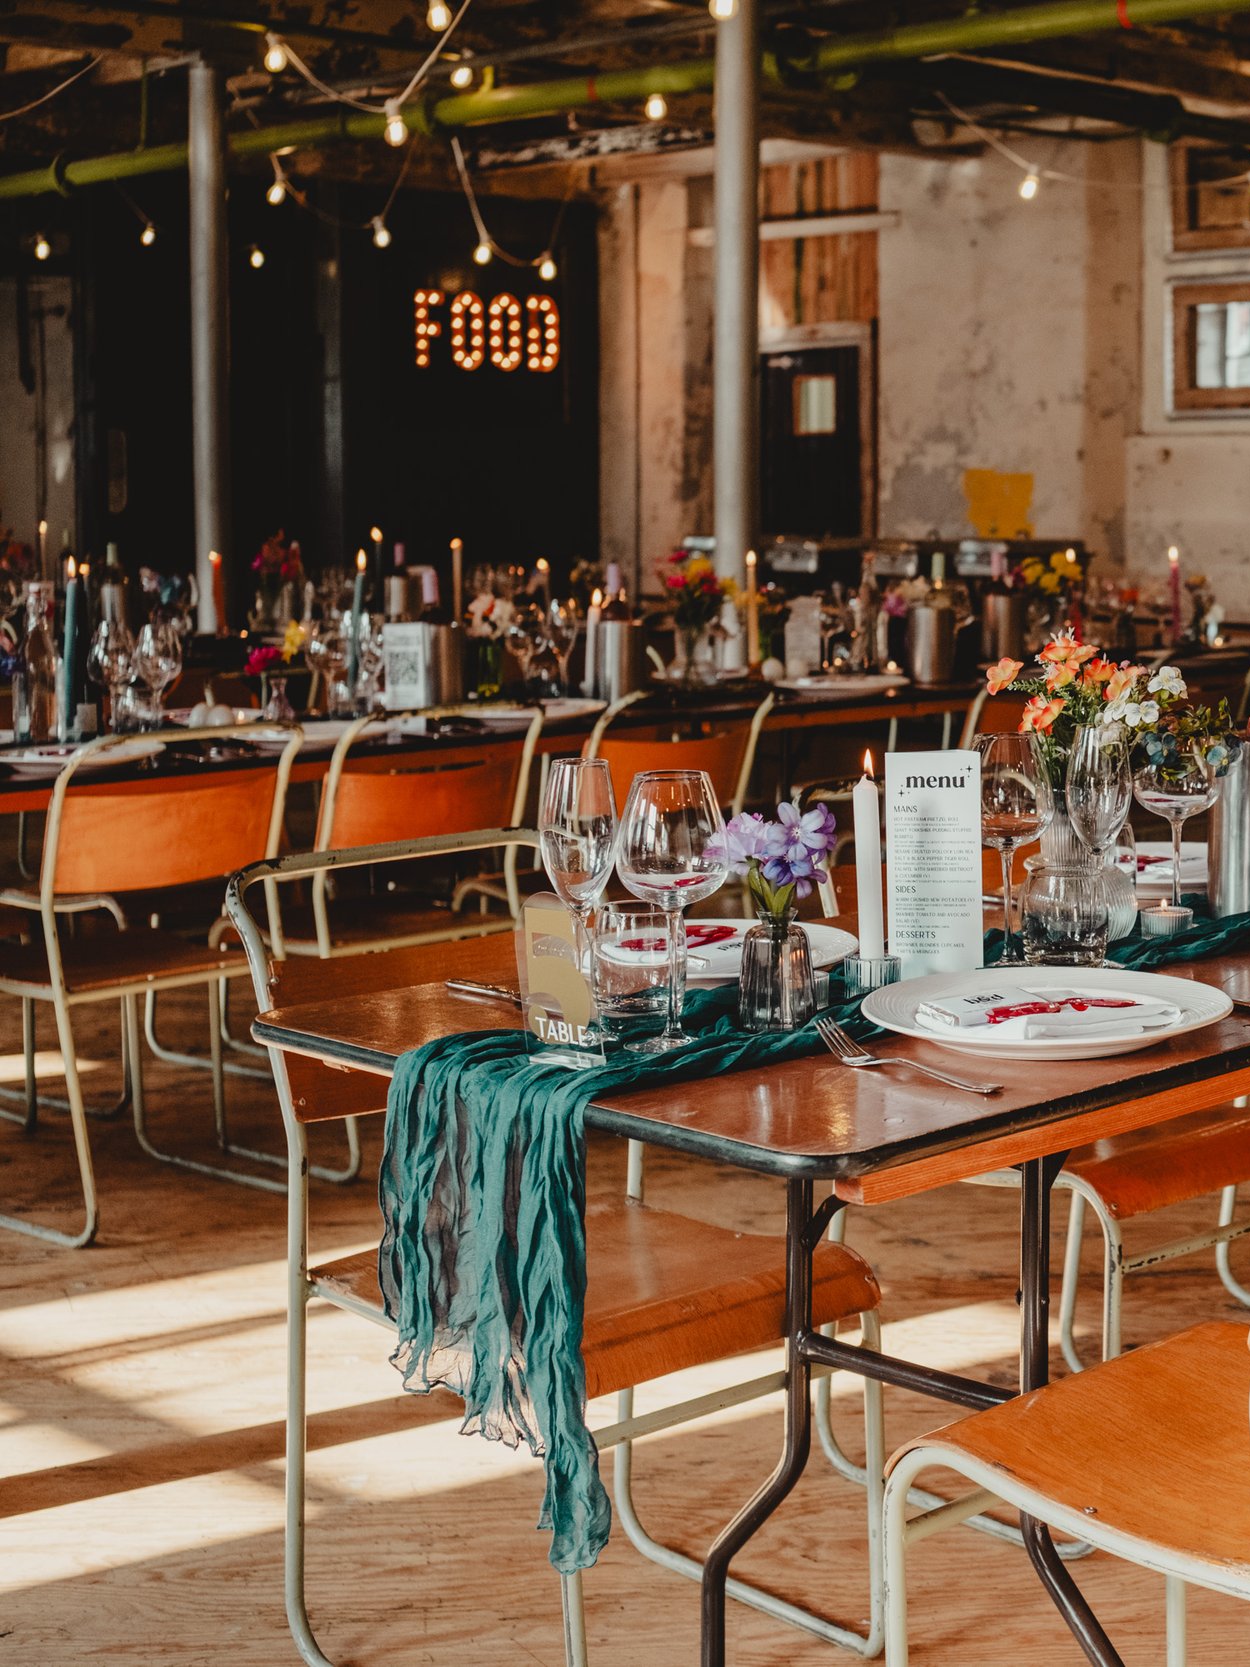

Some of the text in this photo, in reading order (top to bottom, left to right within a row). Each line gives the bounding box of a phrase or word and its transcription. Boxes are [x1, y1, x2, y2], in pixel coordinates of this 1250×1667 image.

[414, 289, 561, 372] FOOD
[906, 775, 966, 789] menu
[893, 805, 919, 814] MAINS
[895, 885, 917, 894] SIDES
[895, 930, 936, 939] DESSERTS
[523, 907, 591, 1045] 5
[535, 1016, 590, 1047] TABLE
